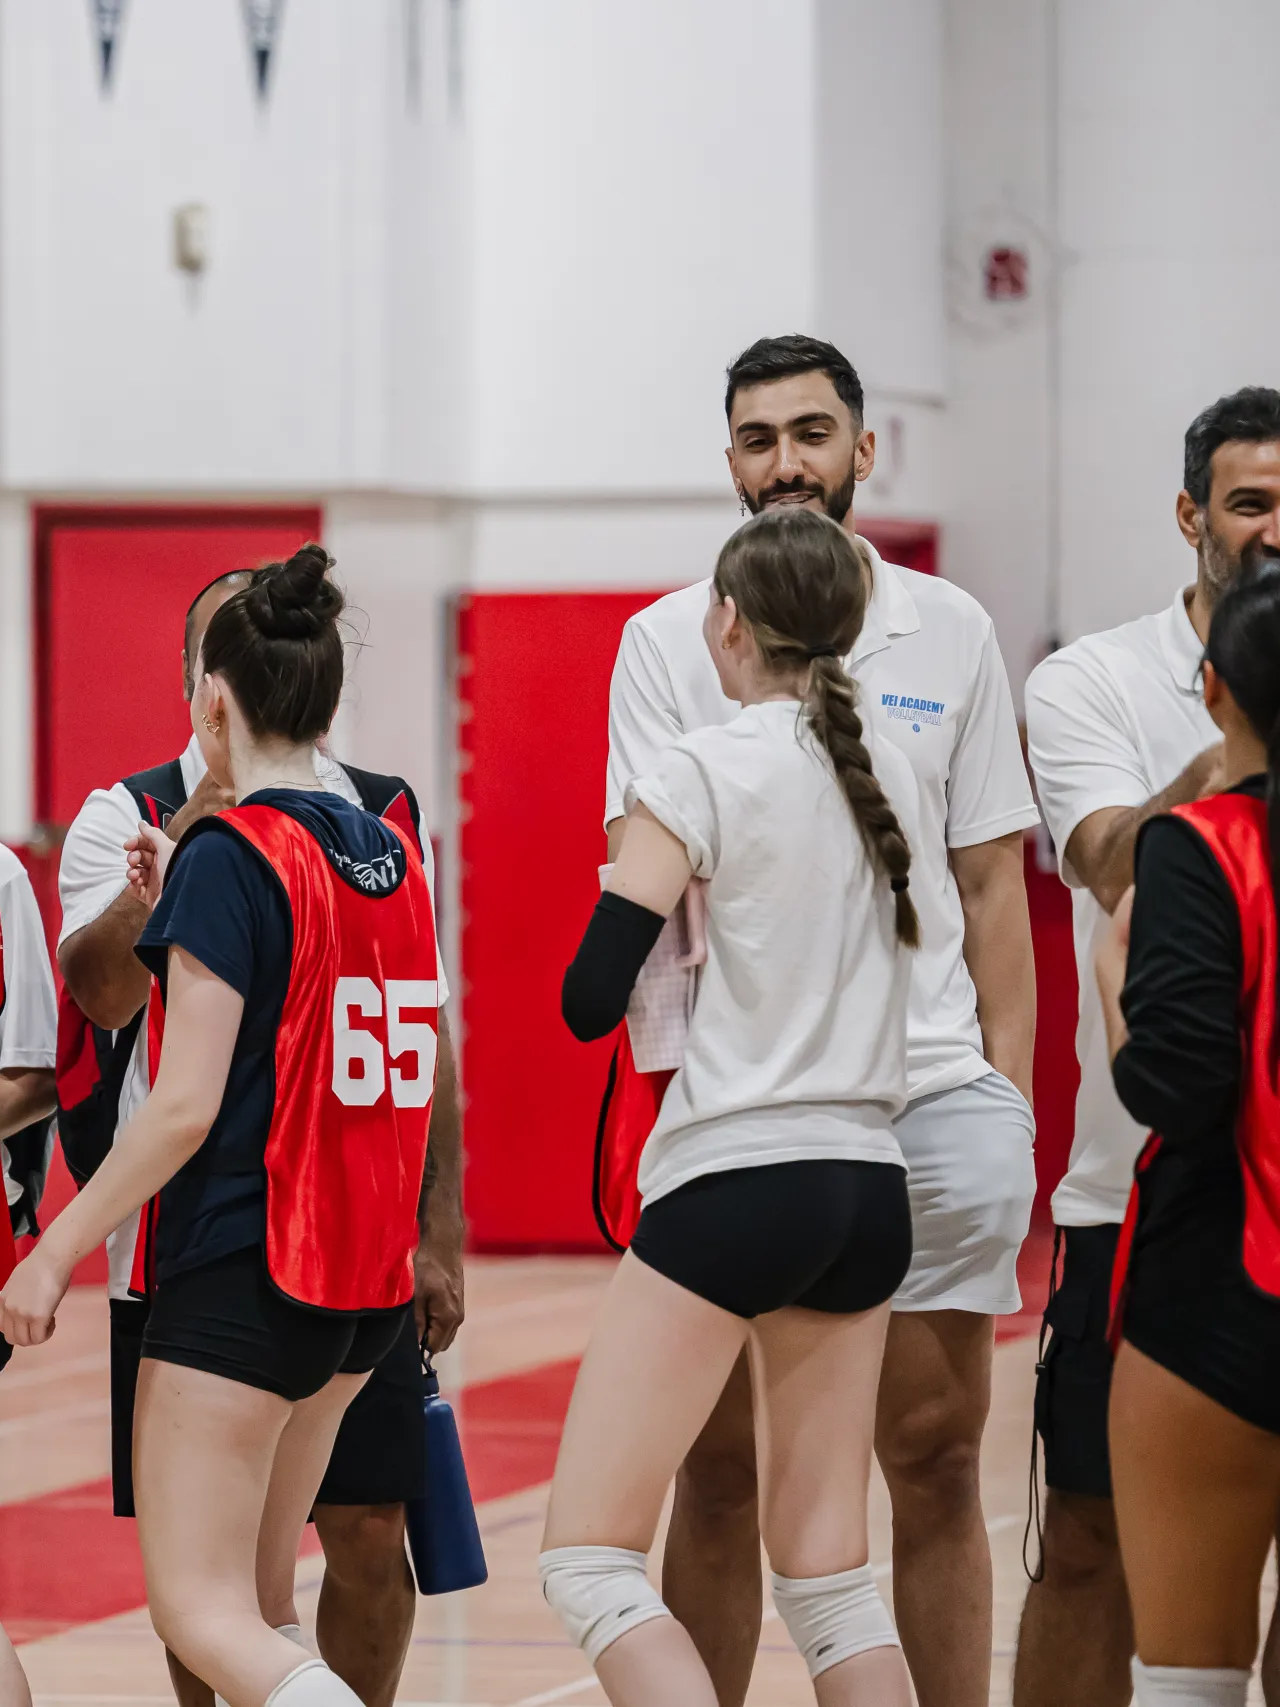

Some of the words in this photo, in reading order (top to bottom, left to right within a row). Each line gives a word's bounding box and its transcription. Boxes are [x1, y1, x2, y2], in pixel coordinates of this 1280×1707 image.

[881, 694, 898, 706] VEI
[900, 696, 945, 714] ACADEMY
[887, 707, 942, 726] VOLLEYBALL
[332, 976, 438, 1108] 65
